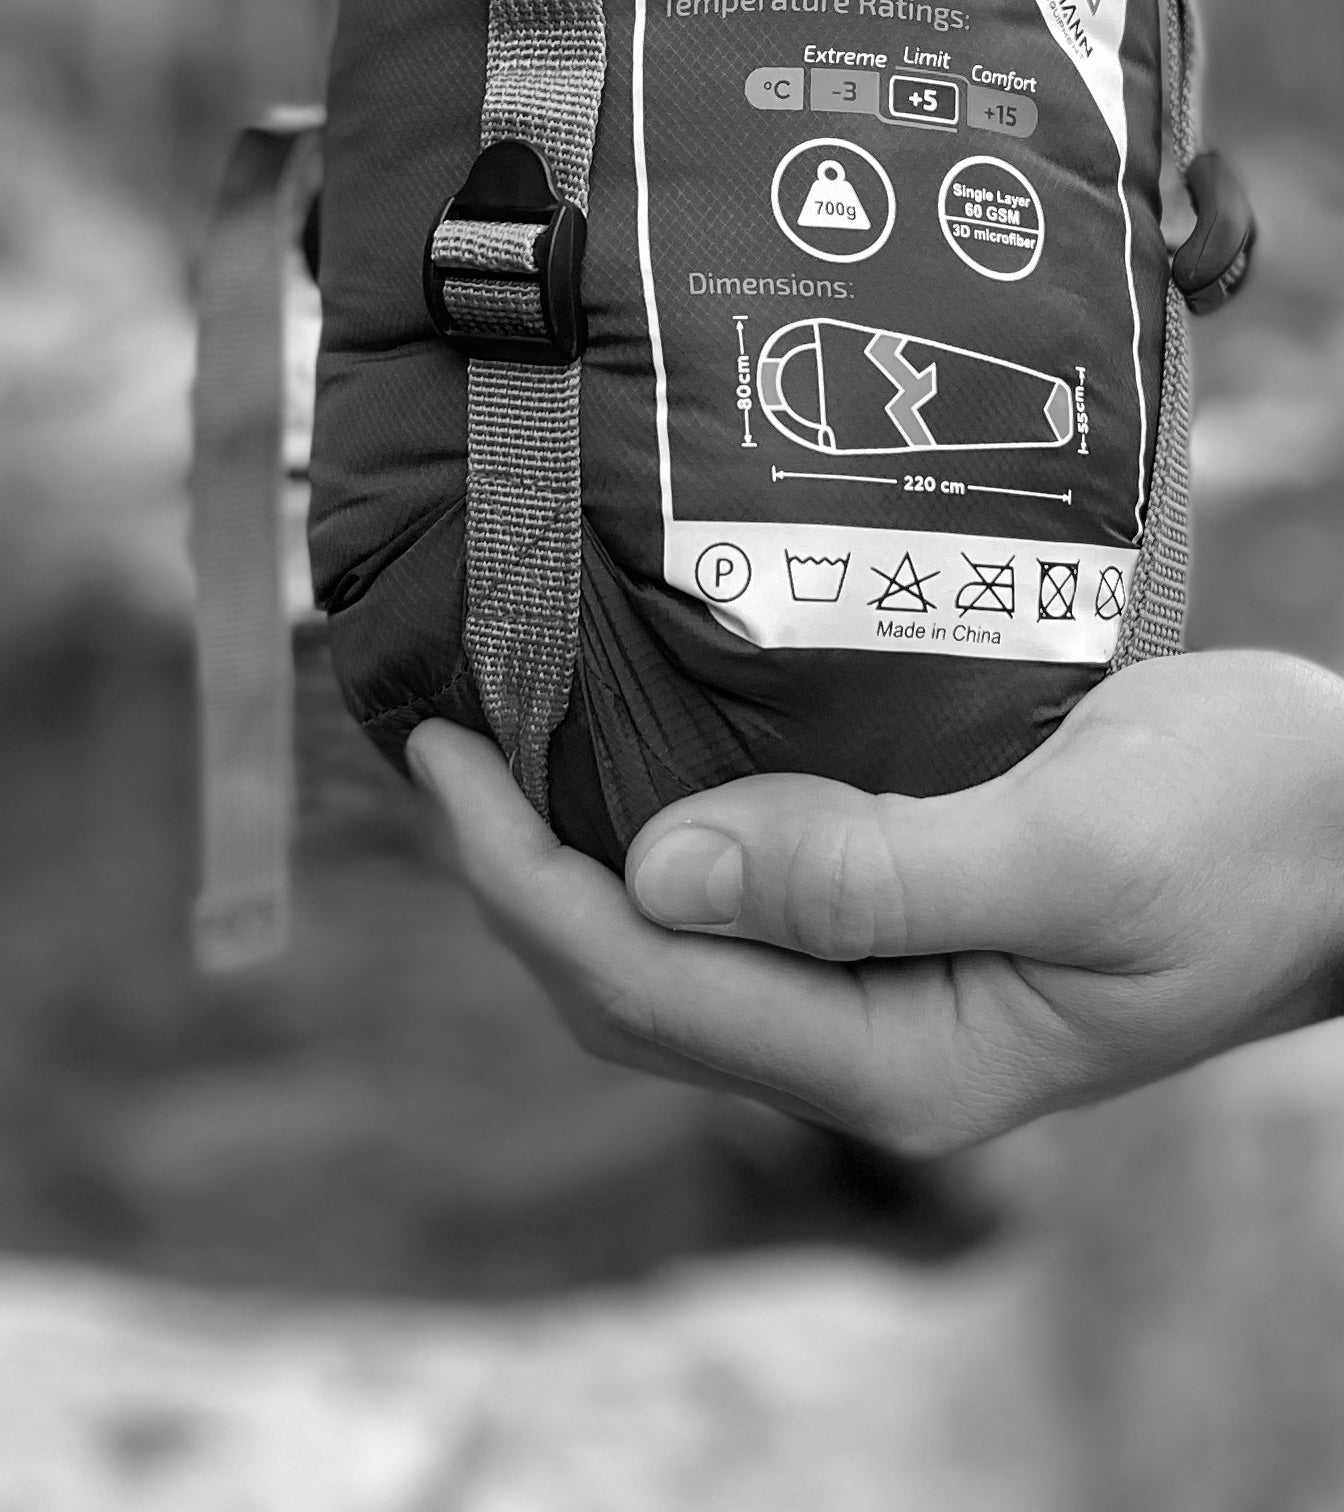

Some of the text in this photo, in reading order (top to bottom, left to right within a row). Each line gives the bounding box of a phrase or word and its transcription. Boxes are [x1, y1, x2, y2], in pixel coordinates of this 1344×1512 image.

[804, 44, 1037, 93] Extreme Limit Comfort
[832, 81, 857, 101] -3
[908, 89, 937, 111] +5
[984, 104, 1017, 127] +15
[953, 183, 1031, 208] Single Layer
[814, 200, 857, 221] 700g
[964, 202, 1020, 225] 60 GSM
[952, 223, 1036, 250] 3D microfiber
[688, 272, 855, 299] Dimensions:
[736, 355, 753, 410] 80cm
[1075, 385, 1089, 434] 55cm
[904, 475, 966, 495] 220 cm
[715, 558, 734, 587] P
[876, 620, 1002, 645] Made in China
